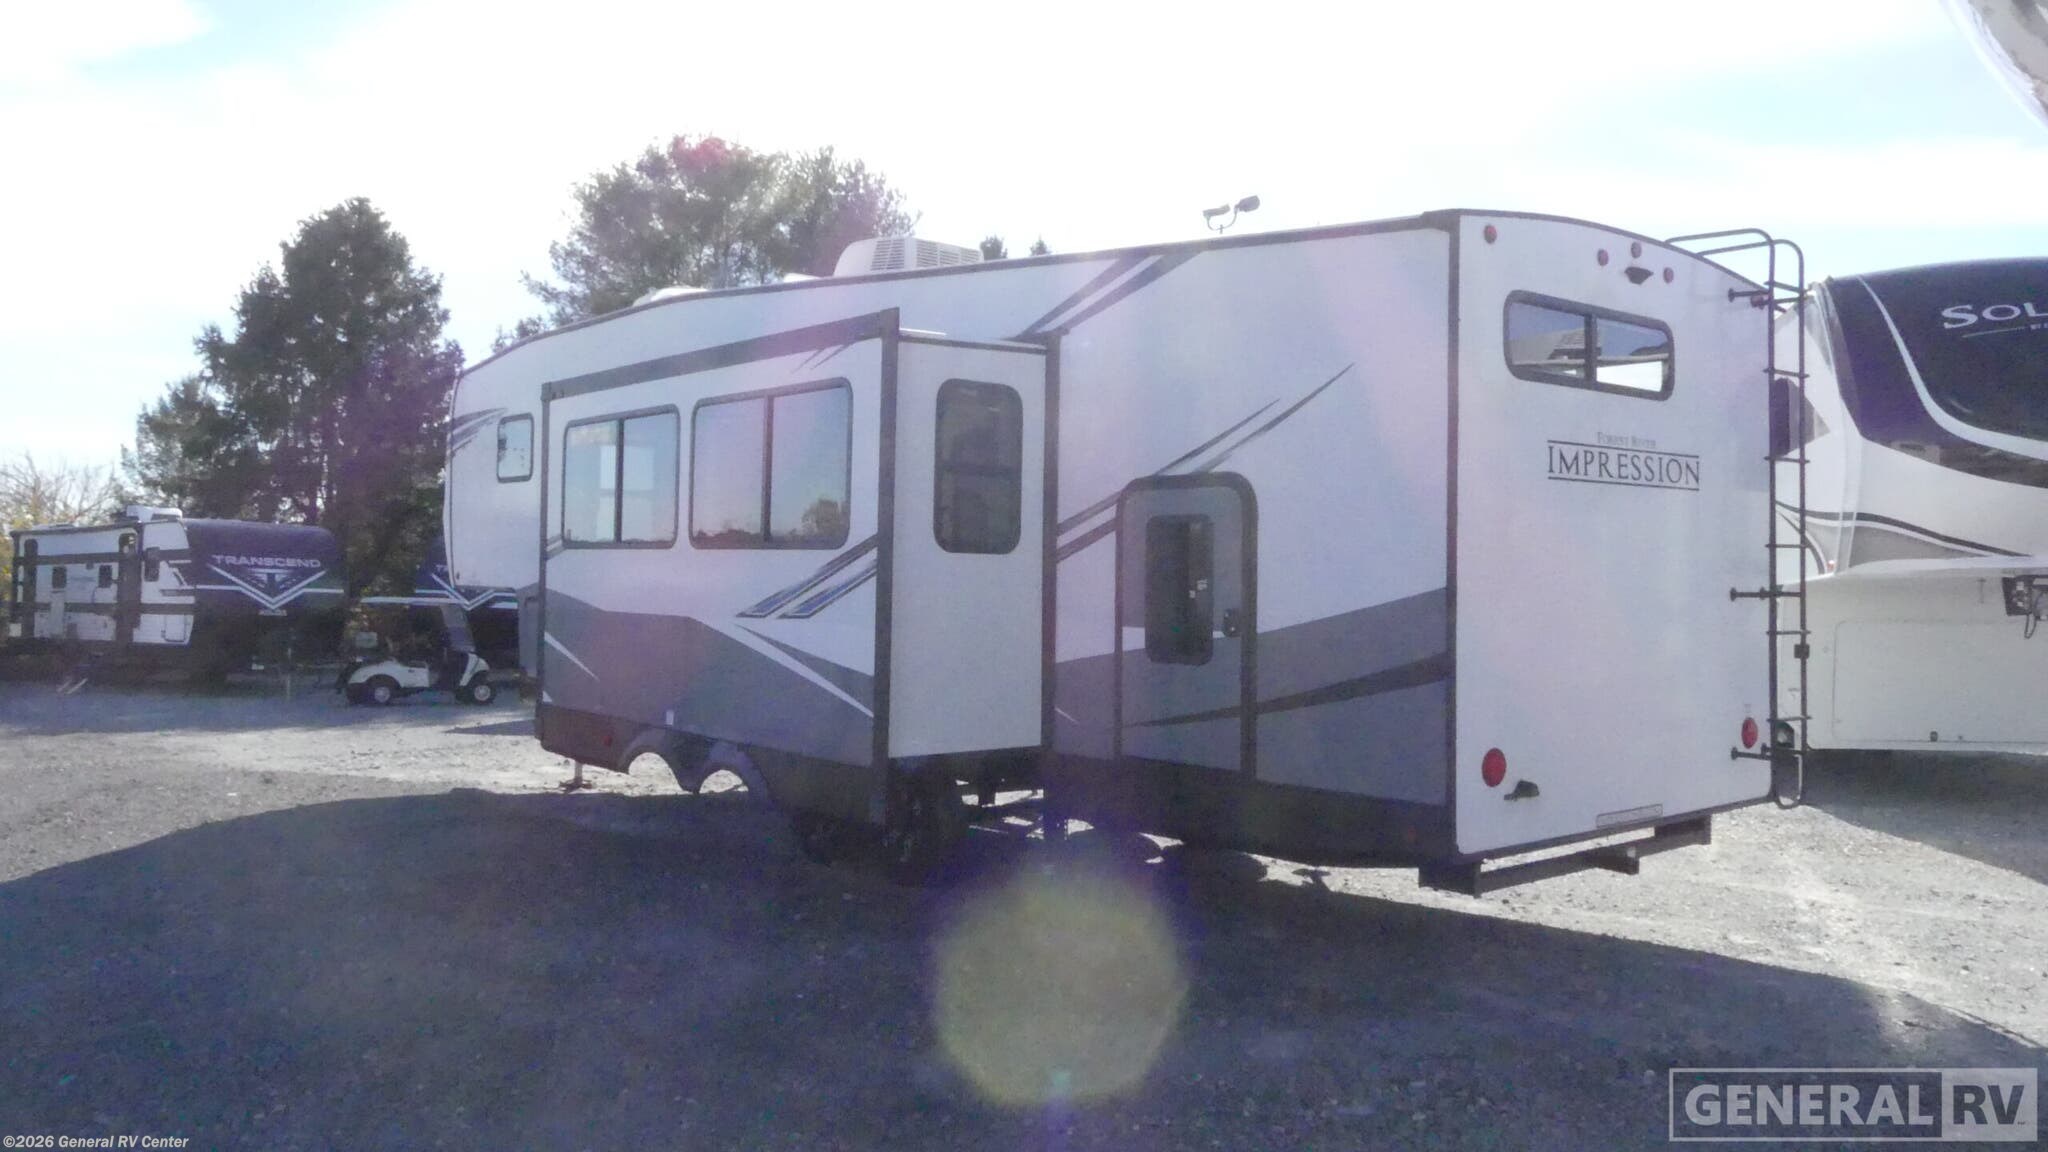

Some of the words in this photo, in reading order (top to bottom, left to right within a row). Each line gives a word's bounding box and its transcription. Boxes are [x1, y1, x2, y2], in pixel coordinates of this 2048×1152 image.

[1941, 302, 2048, 329] SOL
[1548, 446, 1700, 485] IMPRESSION
[211, 554, 321, 568] TRANSCEND
